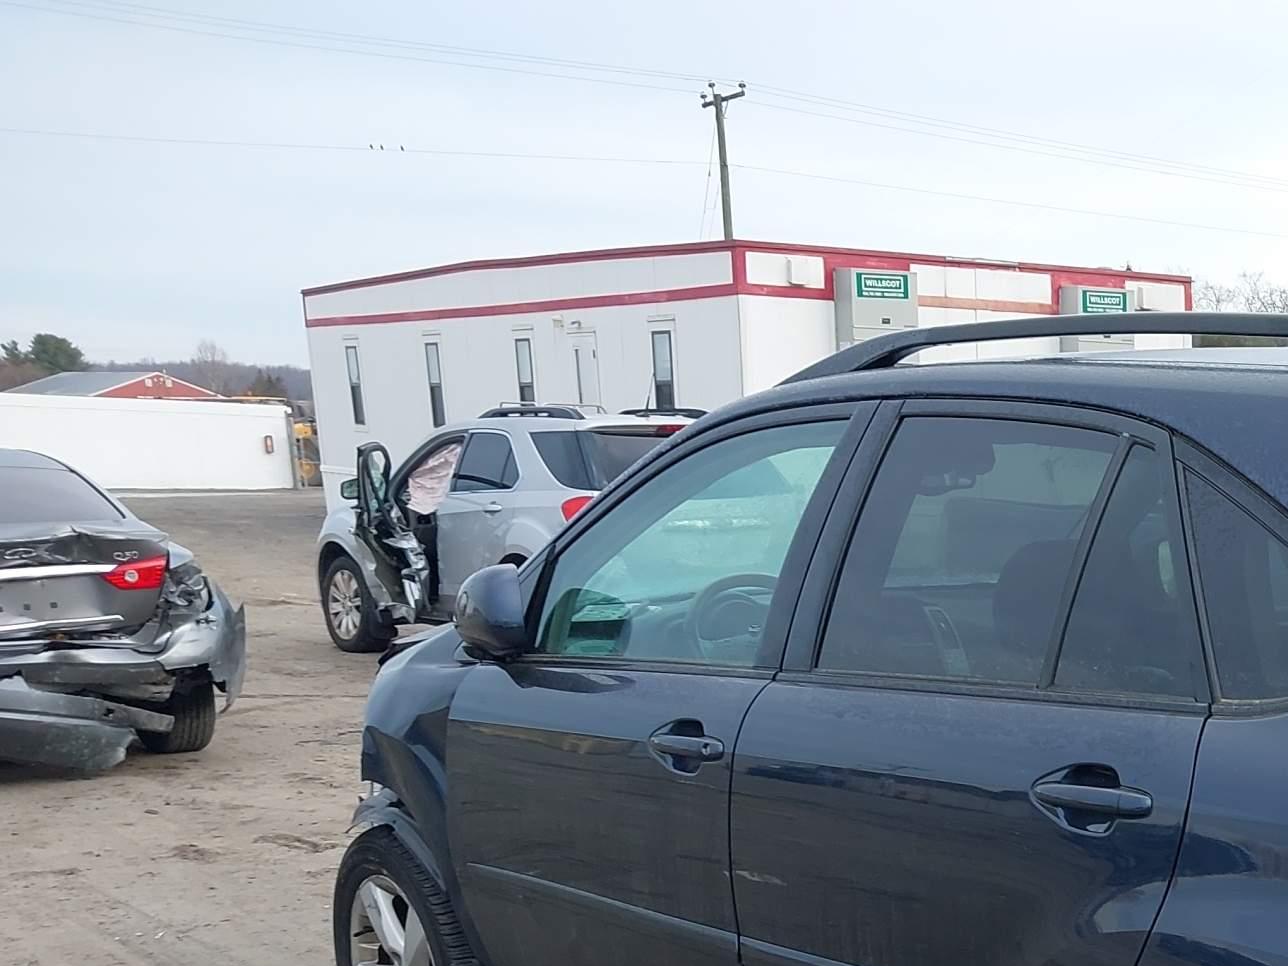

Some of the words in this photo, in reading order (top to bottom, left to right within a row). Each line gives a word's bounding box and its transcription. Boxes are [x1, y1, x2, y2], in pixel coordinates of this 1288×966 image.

[864, 279, 901, 288] WILLSCOT
[1089, 295, 1121, 305] WILLSCOT
[112, 550, 140, 562] Q50
